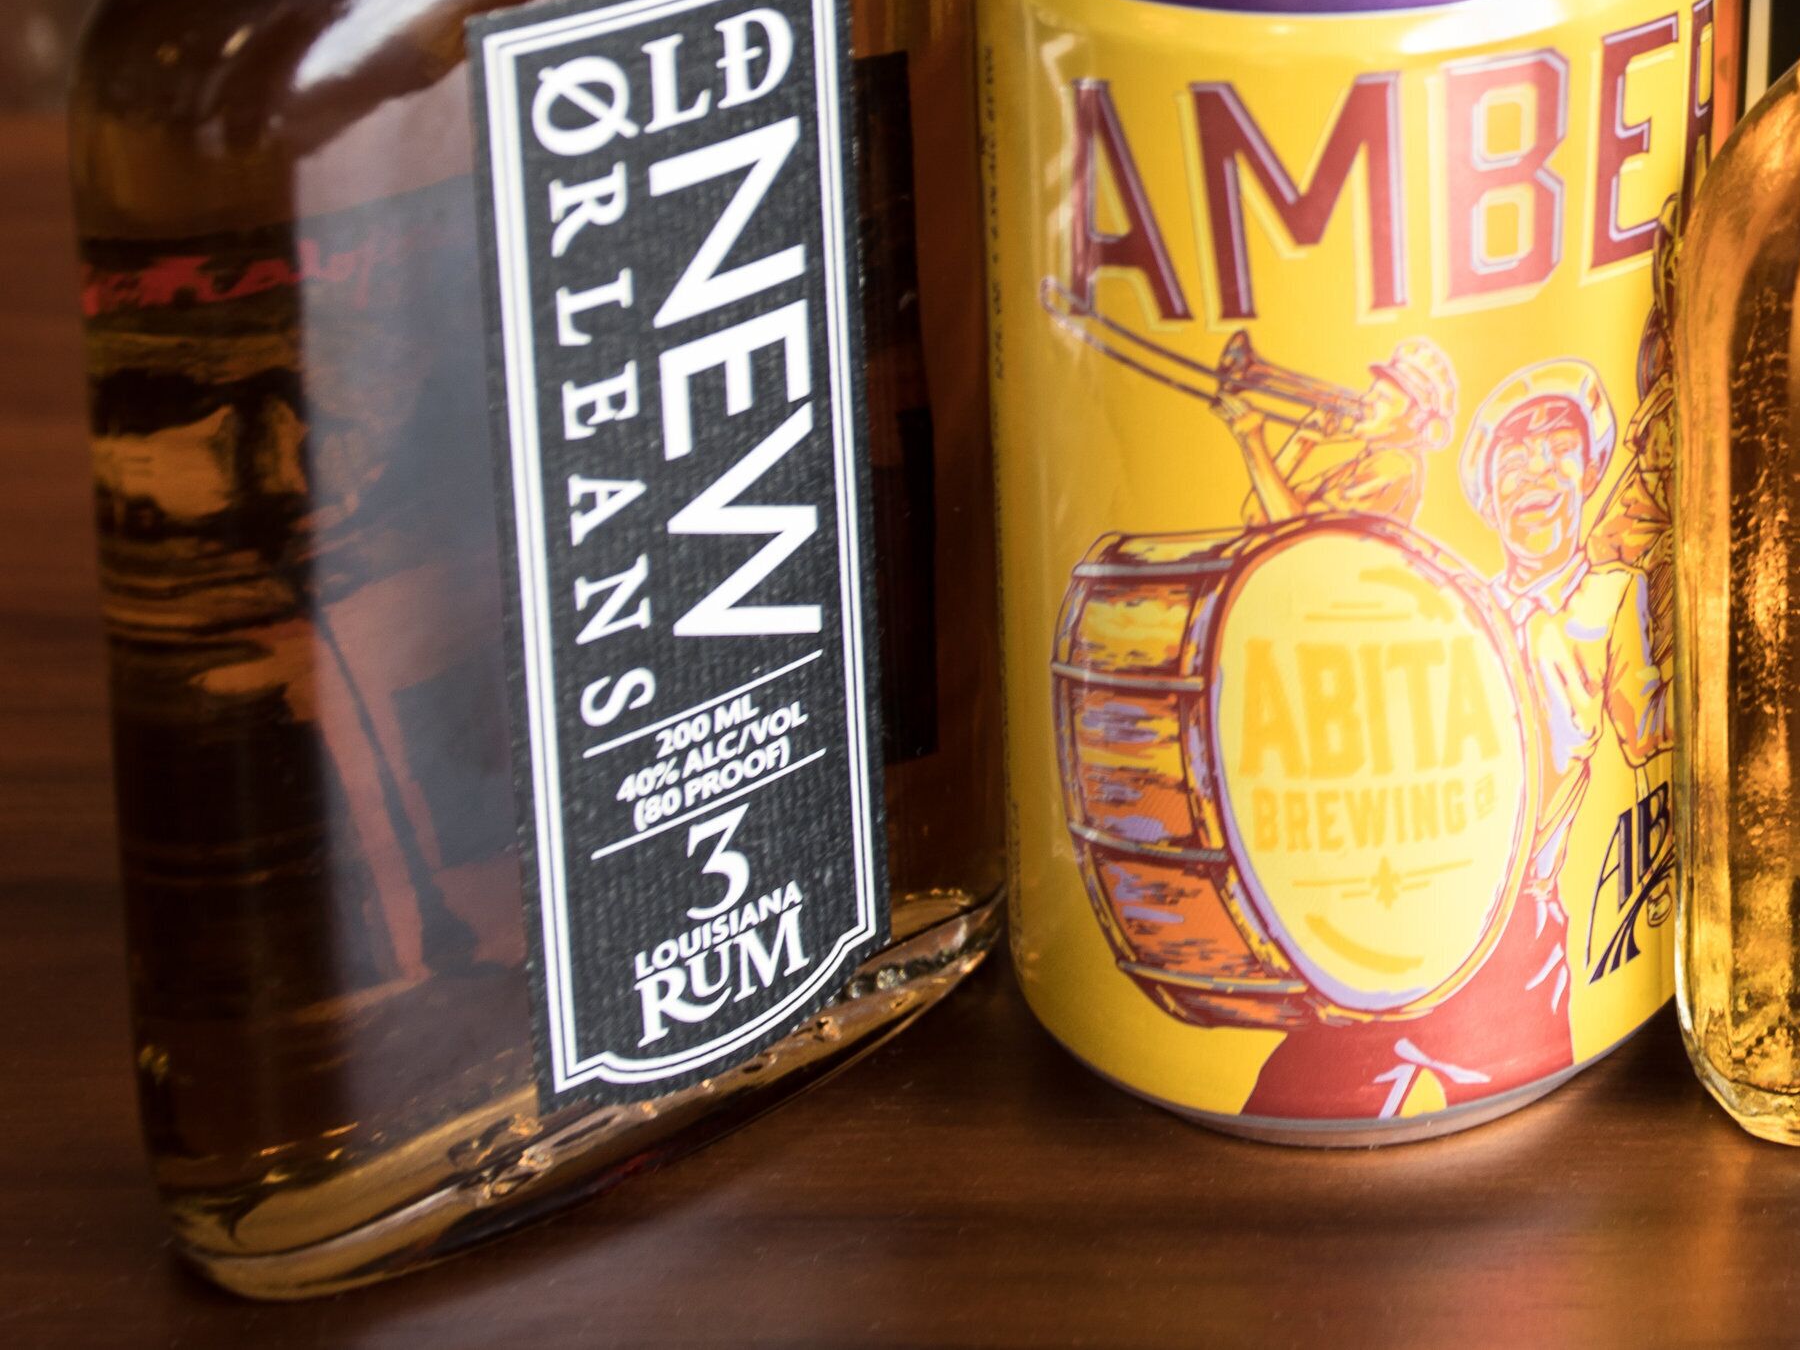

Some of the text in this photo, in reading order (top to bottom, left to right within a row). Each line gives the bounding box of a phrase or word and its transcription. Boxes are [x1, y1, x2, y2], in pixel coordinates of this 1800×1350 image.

[649, 115, 825, 640] NEW
[616, 700, 809, 802] 40% ALC/VOL
[655, 693, 760, 759] 200 ML
[1238, 635, 1501, 781] ABITA
[633, 735, 791, 832] (80 PROOF)
[1251, 778, 1467, 853] BREWING
[686, 802, 750, 920] 3
[633, 903, 810, 1048] RUM
[635, 879, 803, 981] LOUISIANA
